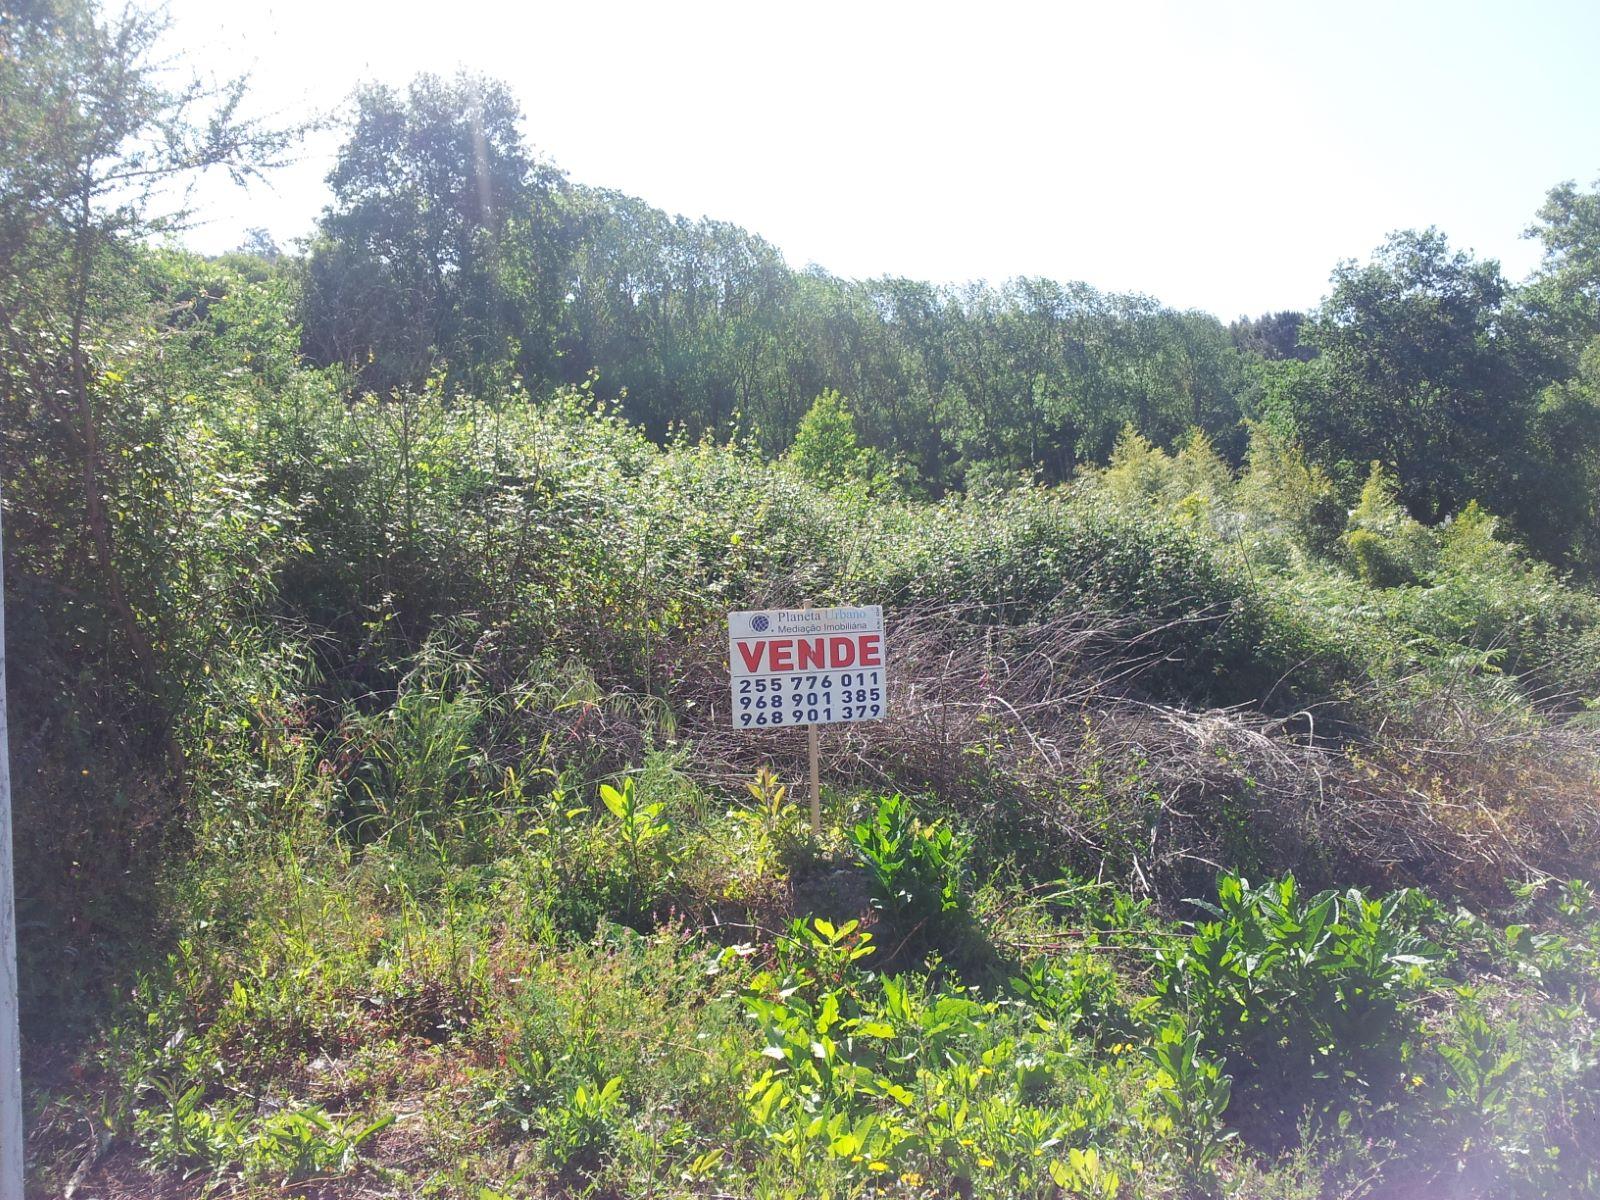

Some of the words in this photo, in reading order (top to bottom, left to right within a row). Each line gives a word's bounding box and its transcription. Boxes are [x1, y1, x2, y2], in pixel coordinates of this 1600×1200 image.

[778, 611, 821, 622] Planeta
[825, 608, 866, 621] Urbano
[778, 624, 823, 634] Mediação
[824, 621, 868, 632] Imobiliária
[736, 635, 881, 673] VENDE
[739, 677, 782, 694] 255
[790, 675, 832, 690] 776
[841, 672, 878, 687] 011
[739, 694, 783, 710] 968
[791, 691, 831, 707] 901
[841, 688, 880, 703] 385
[740, 711, 783, 726] 968
[792, 708, 831, 722] 901
[842, 704, 880, 719] 379
